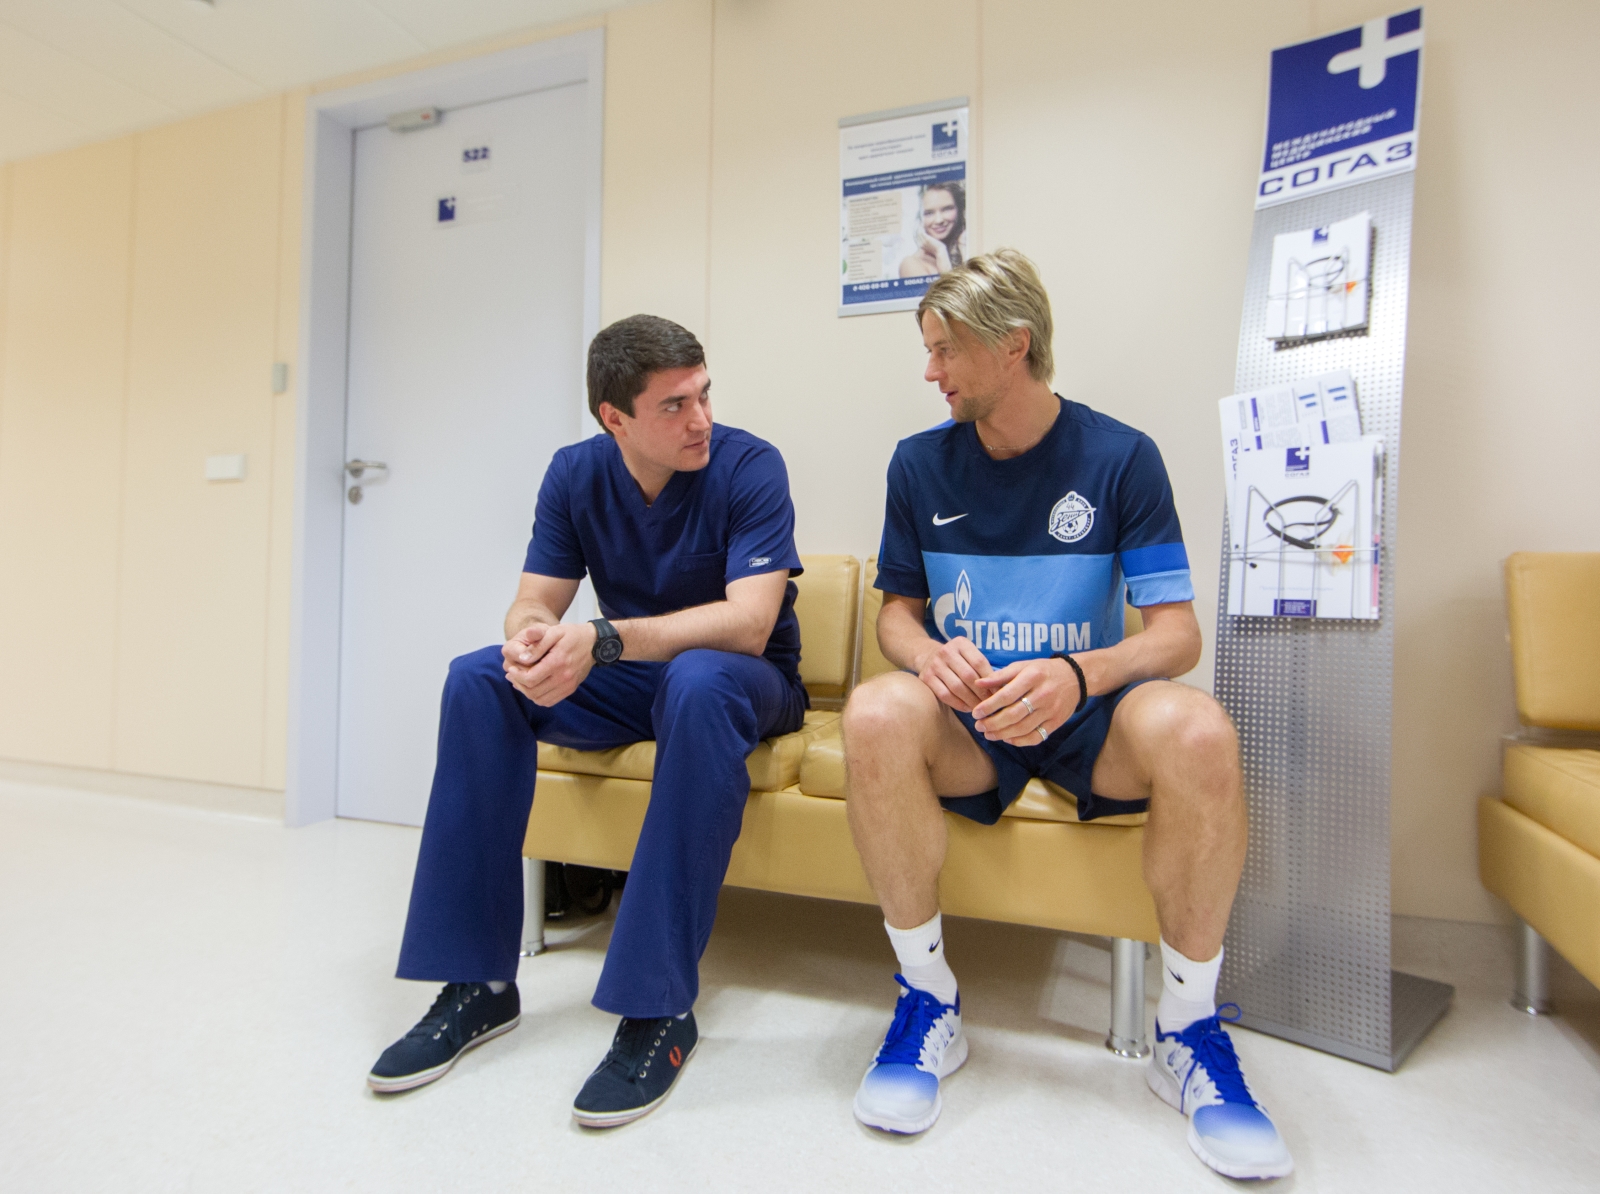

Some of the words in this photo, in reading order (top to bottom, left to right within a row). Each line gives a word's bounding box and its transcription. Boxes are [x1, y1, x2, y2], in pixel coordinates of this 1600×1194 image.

[463, 146, 489, 162] 522
[1270, 150, 1312, 168] ЦЕНТР
[1259, 141, 1413, 196] СОГАЗ
[975, 621, 1091, 652] ГАЗПРОМ
